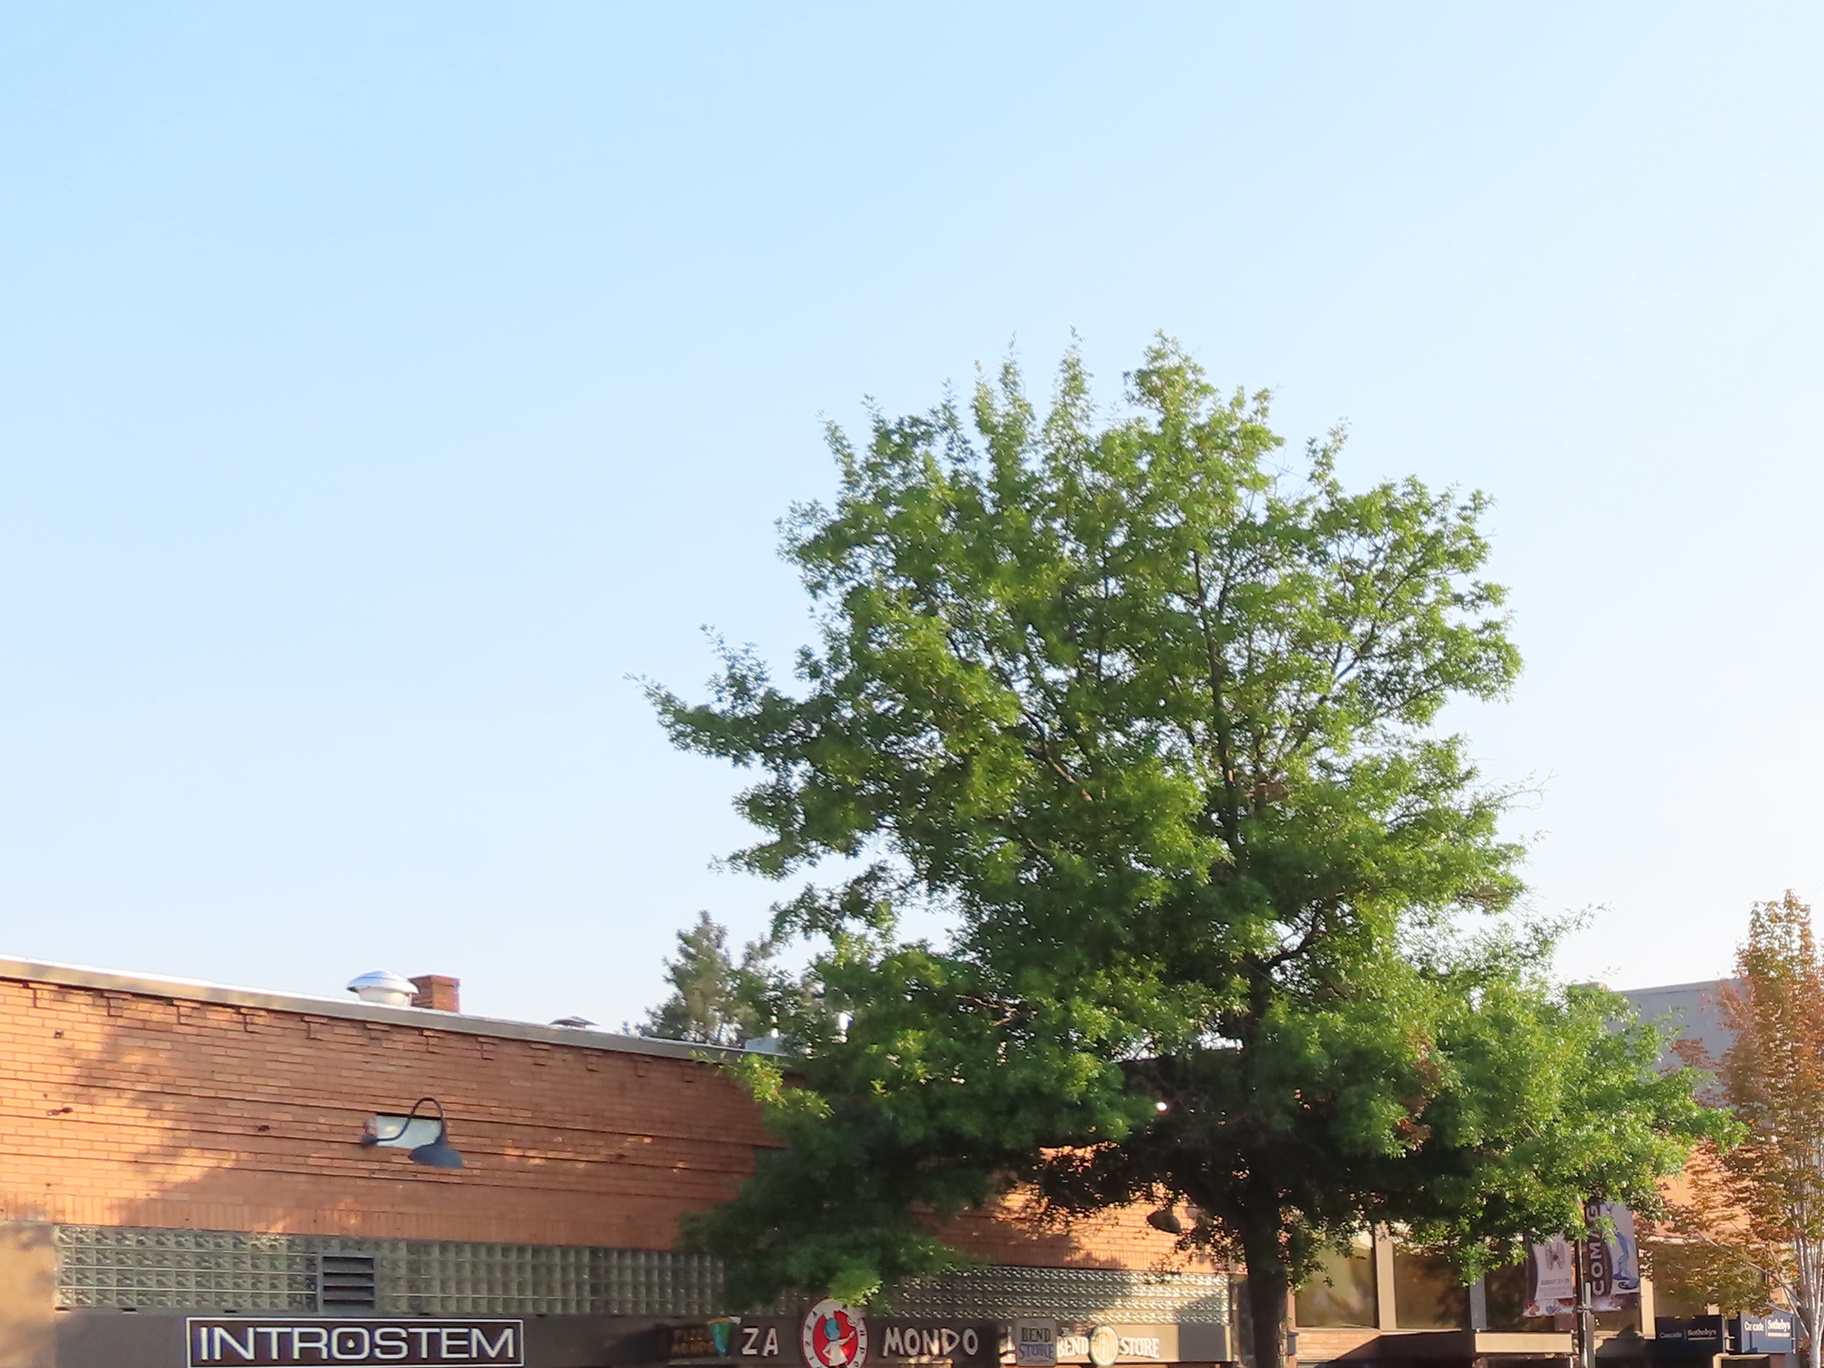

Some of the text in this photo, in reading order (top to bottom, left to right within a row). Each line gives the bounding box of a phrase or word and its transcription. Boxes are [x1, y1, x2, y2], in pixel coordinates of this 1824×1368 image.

[199, 1326, 515, 1360] INTROSTEM
[882, 1326, 979, 1358] MONDO
[1021, 1327, 1051, 1342] BEND
[1019, 1343, 1054, 1361] STORE
[1057, 1336, 1160, 1359] BEND STORE
